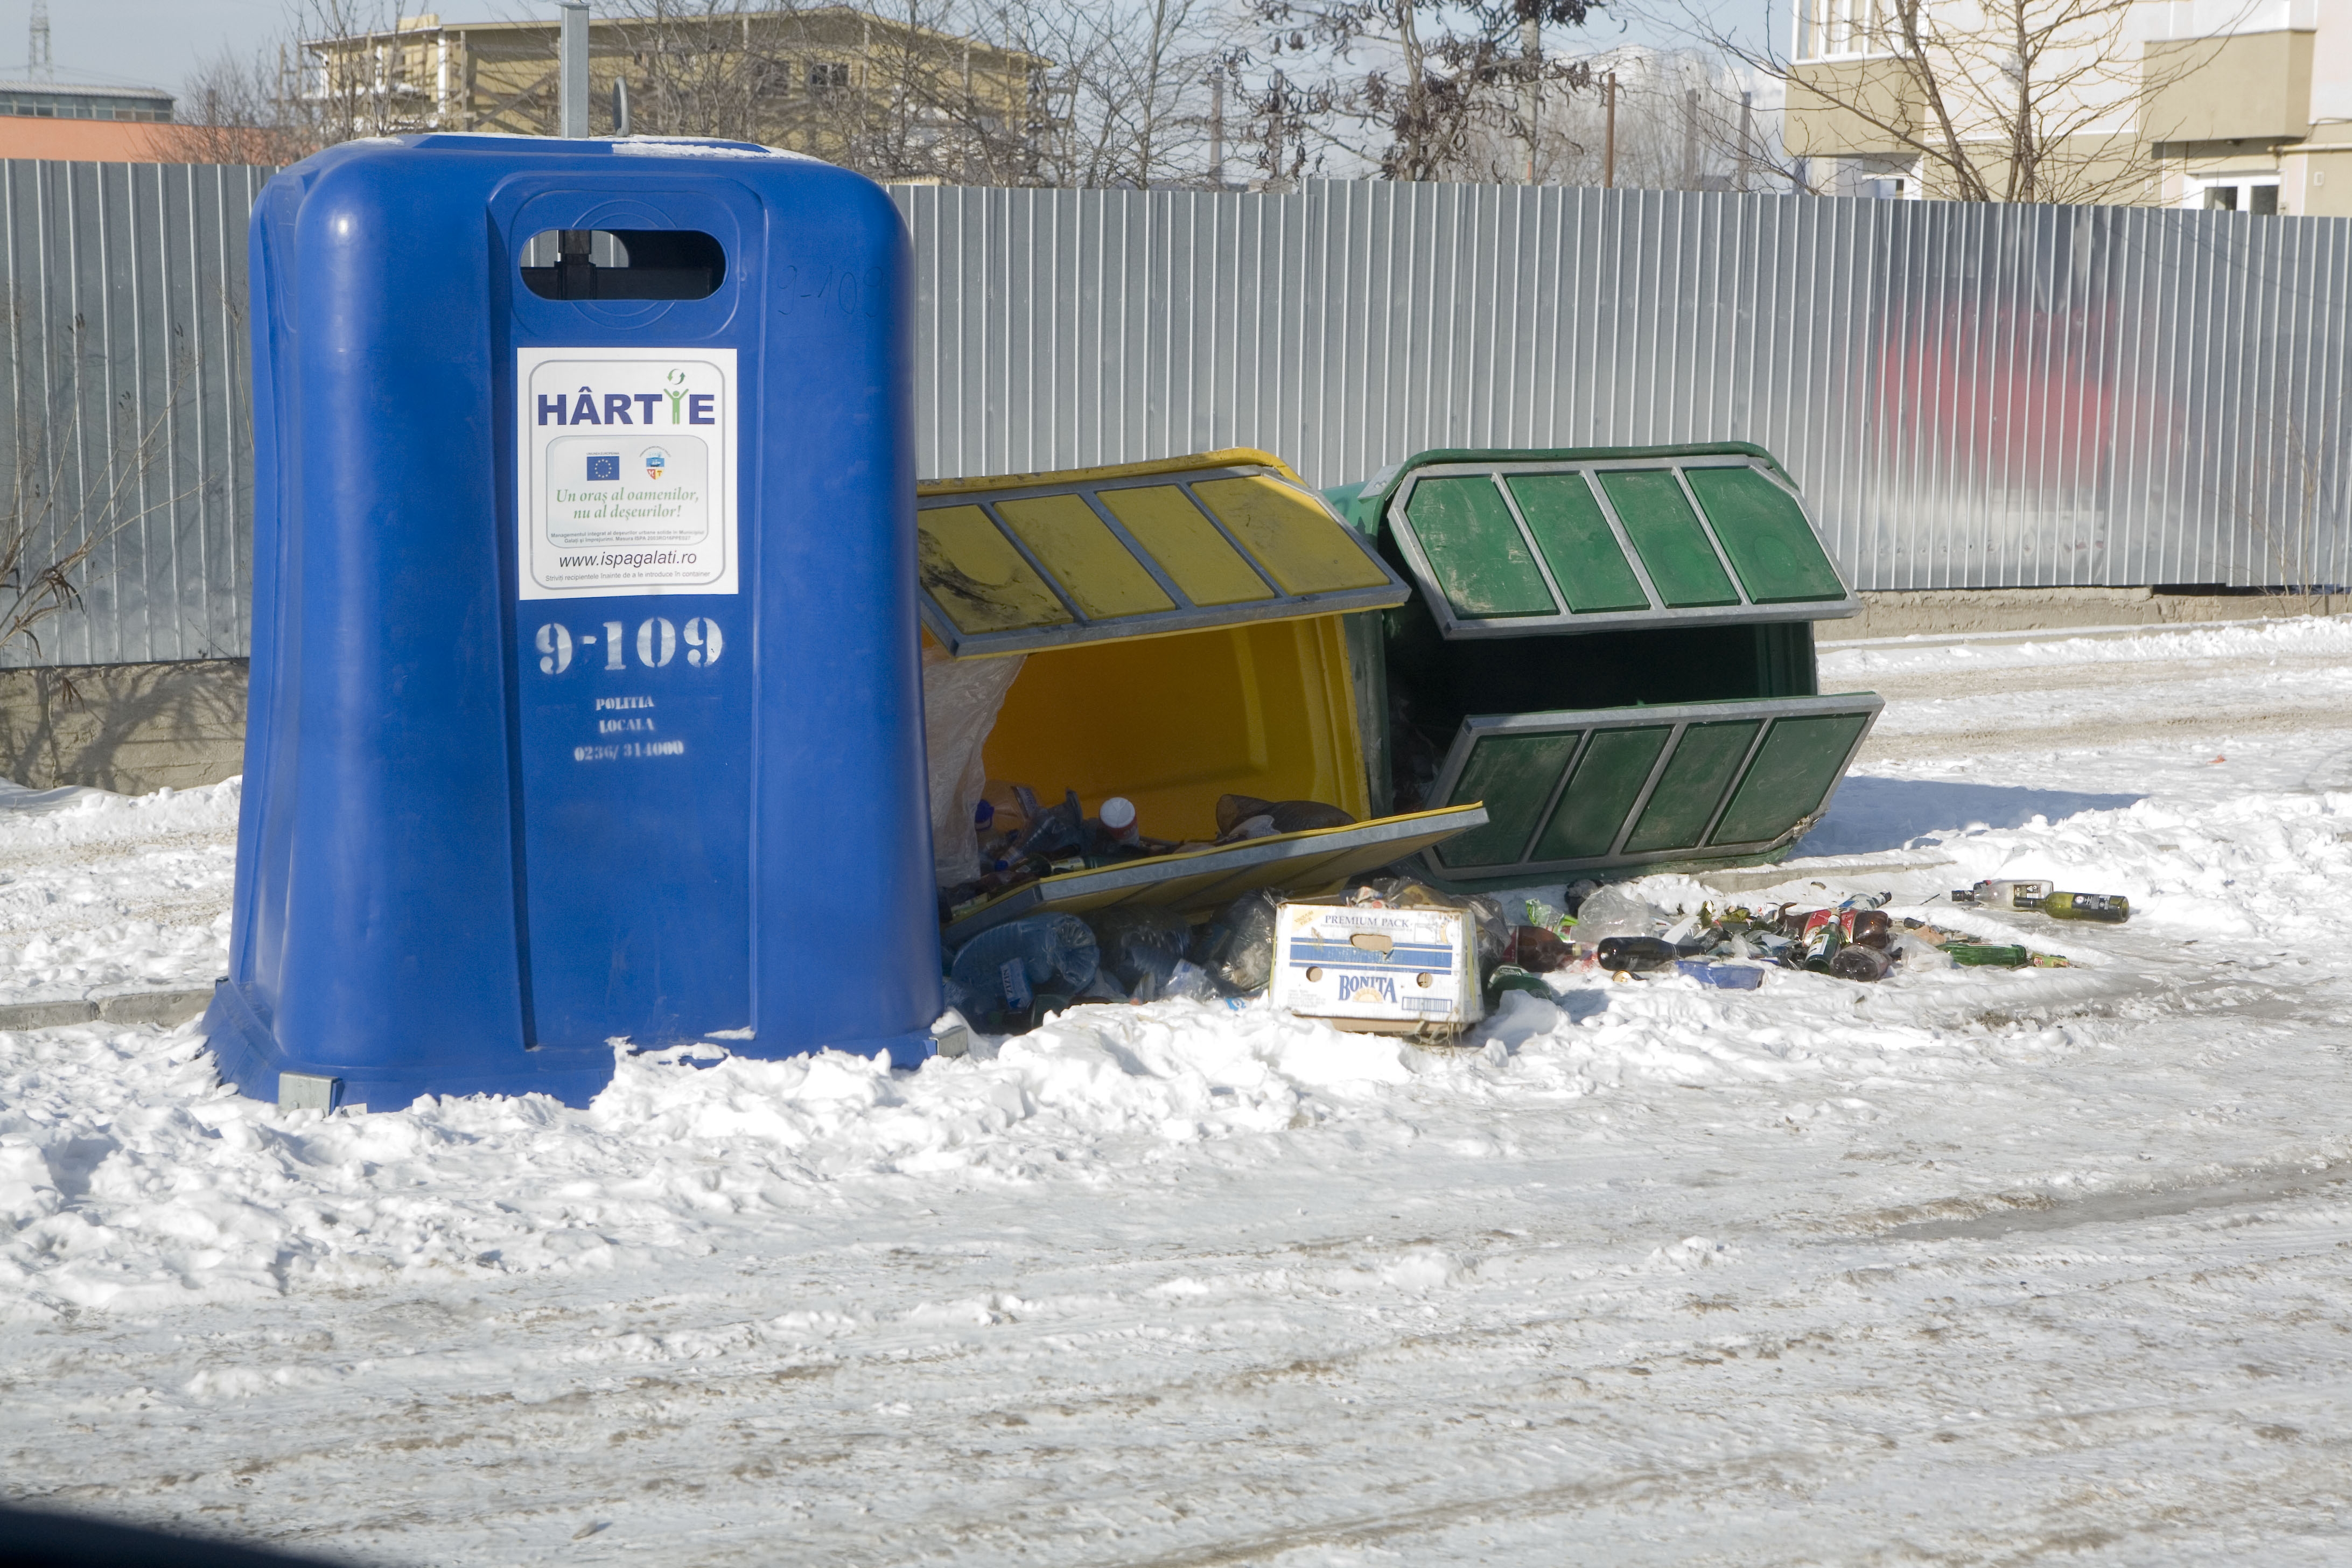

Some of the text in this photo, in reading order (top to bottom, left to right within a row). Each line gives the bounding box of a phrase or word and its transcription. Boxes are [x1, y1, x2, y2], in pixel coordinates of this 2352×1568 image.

[777, 265, 884, 318] 9-109
[556, 489, 576, 502] Un
[611, 487, 624, 501] al
[627, 487, 699, 503] oamenilor,
[573, 509, 590, 519] nu
[594, 505, 607, 518] al
[559, 550, 697, 568] www.ispagalati.ro
[565, 573, 599, 581] recipientele
[535, 617, 723, 675] 9-109
[596, 696, 655, 711] POLITIA
[599, 718, 655, 734] LOCALA
[1325, 915, 1377, 926] PREMIUM
[1382, 918, 1409, 927] PACK
[1338, 975, 1397, 1003] BONITA
